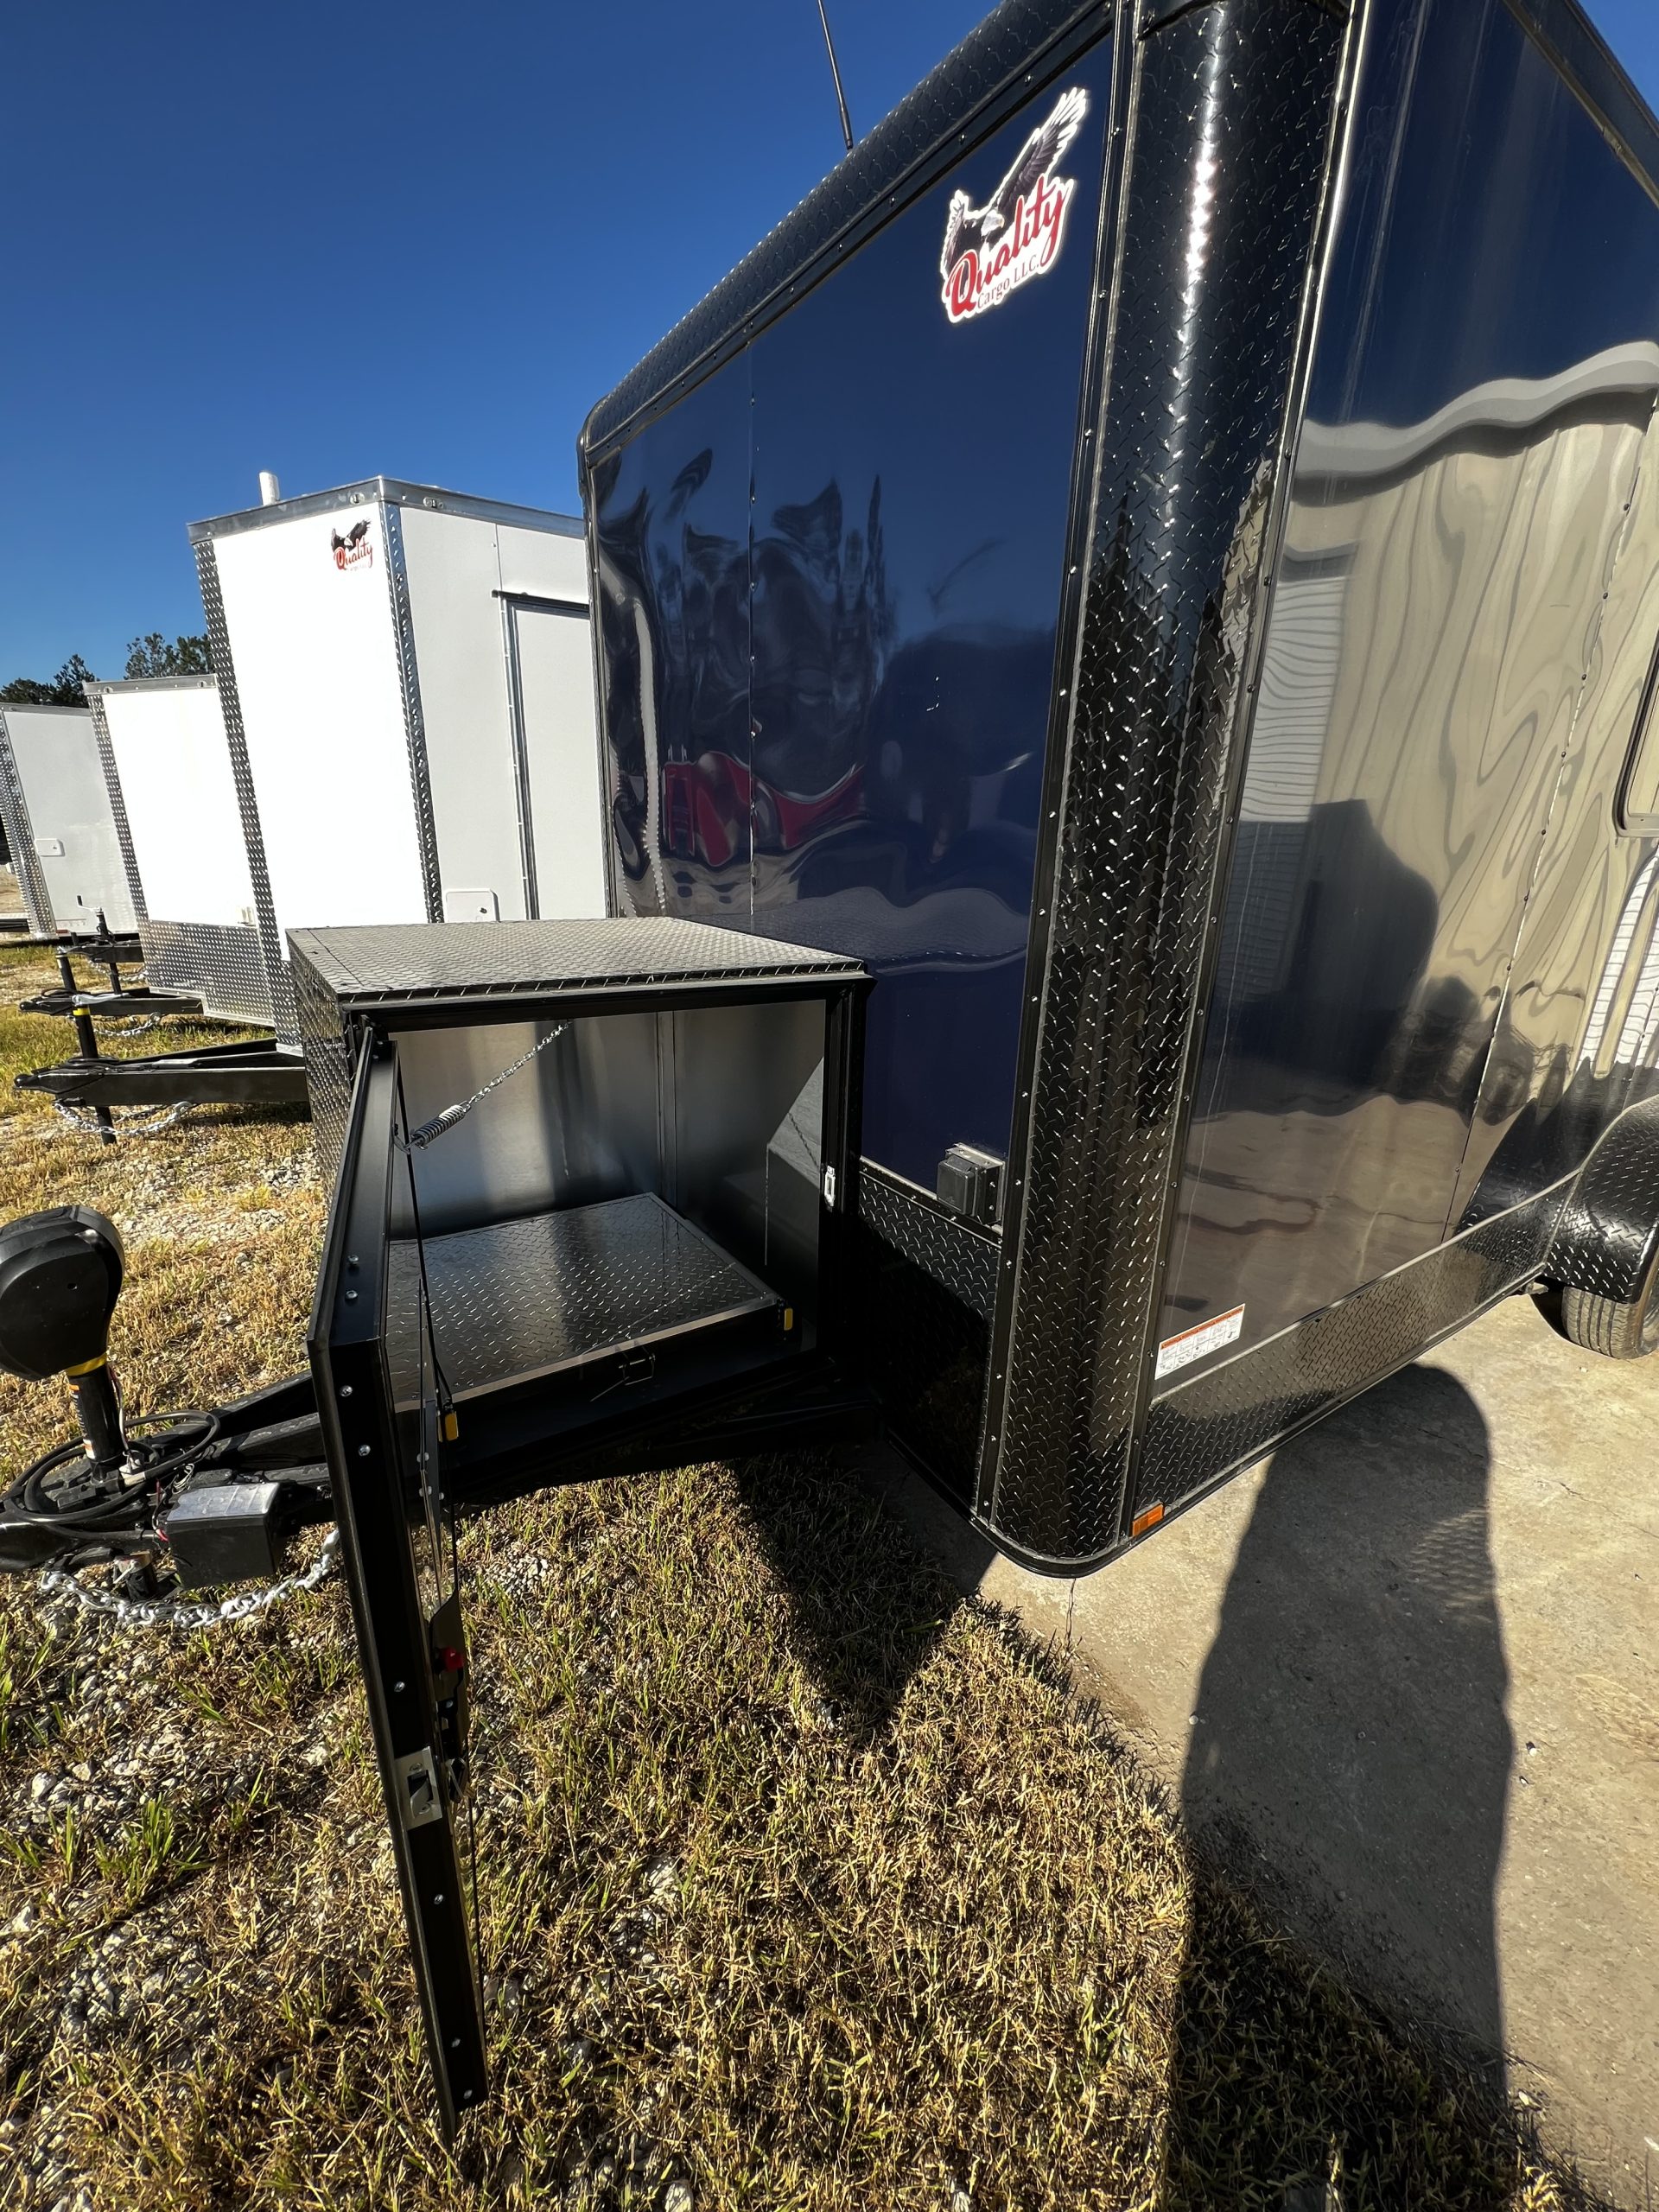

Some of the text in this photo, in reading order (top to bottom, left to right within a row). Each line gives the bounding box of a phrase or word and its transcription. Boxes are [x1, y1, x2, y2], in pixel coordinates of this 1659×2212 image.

[946, 174, 1065, 317] Quality
[977, 277, 1010, 308] Cargo
[334, 536, 373, 570] Quality
